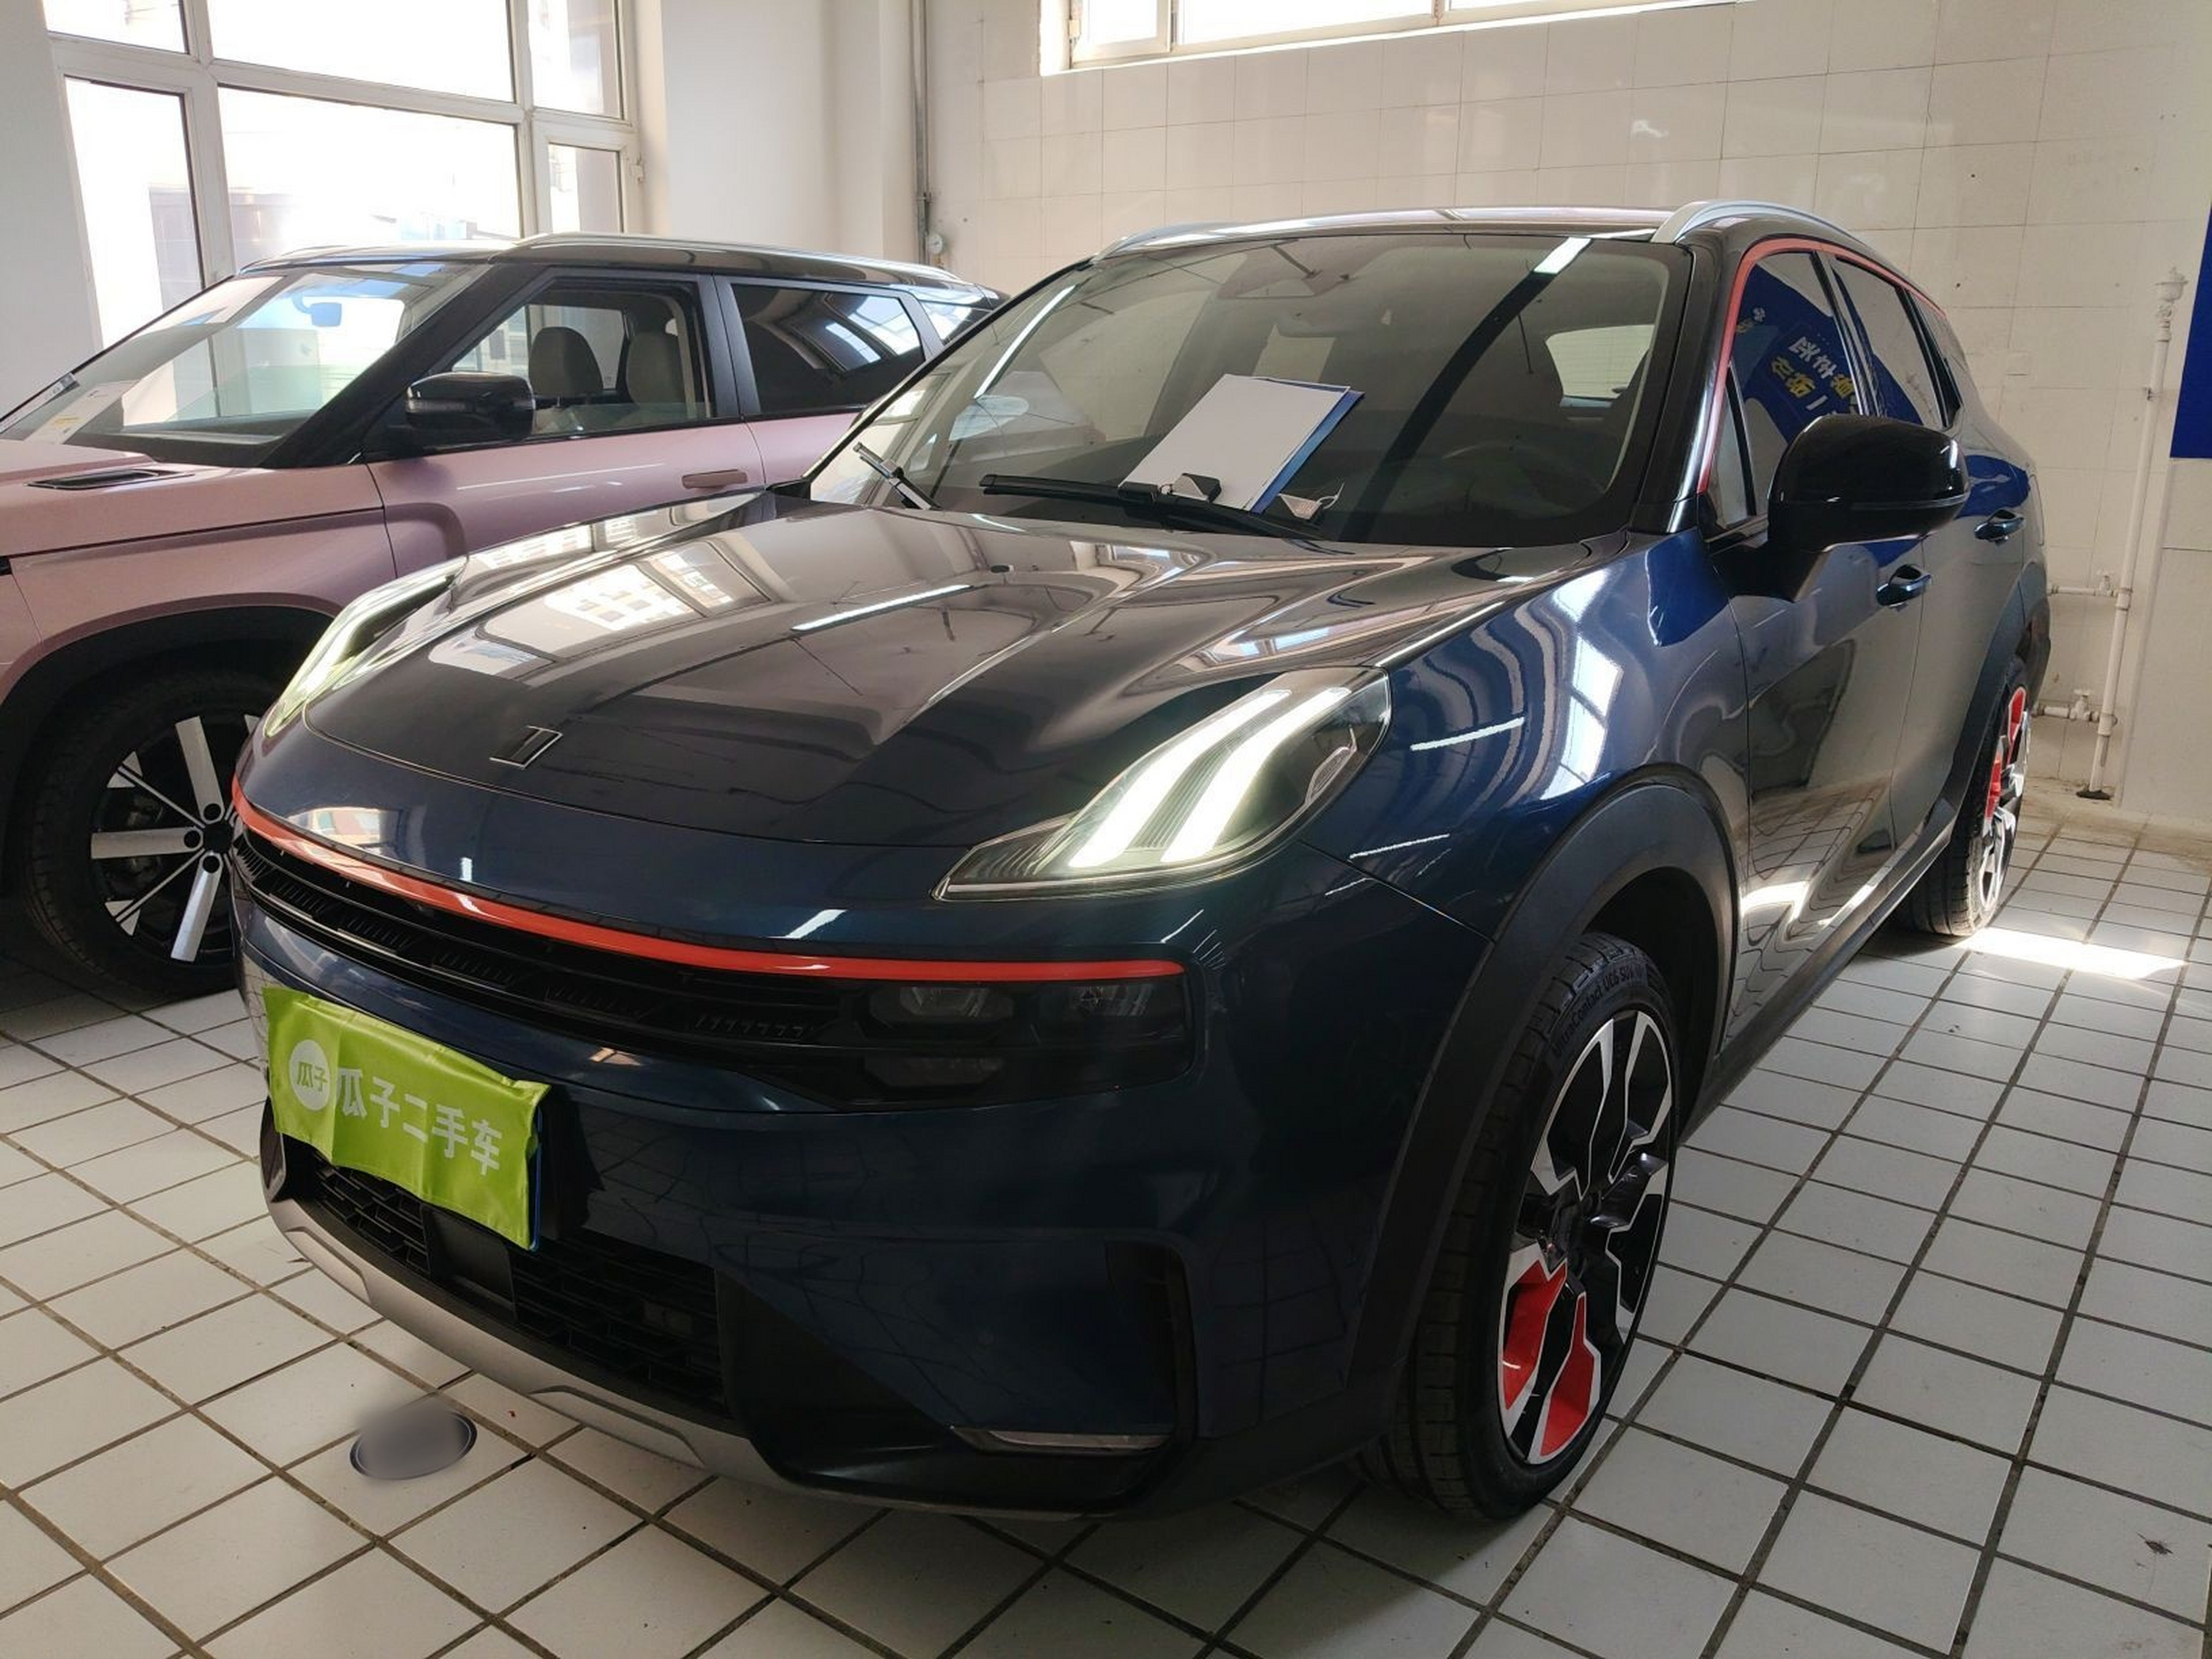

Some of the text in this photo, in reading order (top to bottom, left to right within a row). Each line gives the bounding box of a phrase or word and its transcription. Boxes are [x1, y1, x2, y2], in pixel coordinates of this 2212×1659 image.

[297, 1061, 328, 1093] 瓜子
[336, 1067, 502, 1176] 瓜子二手车
